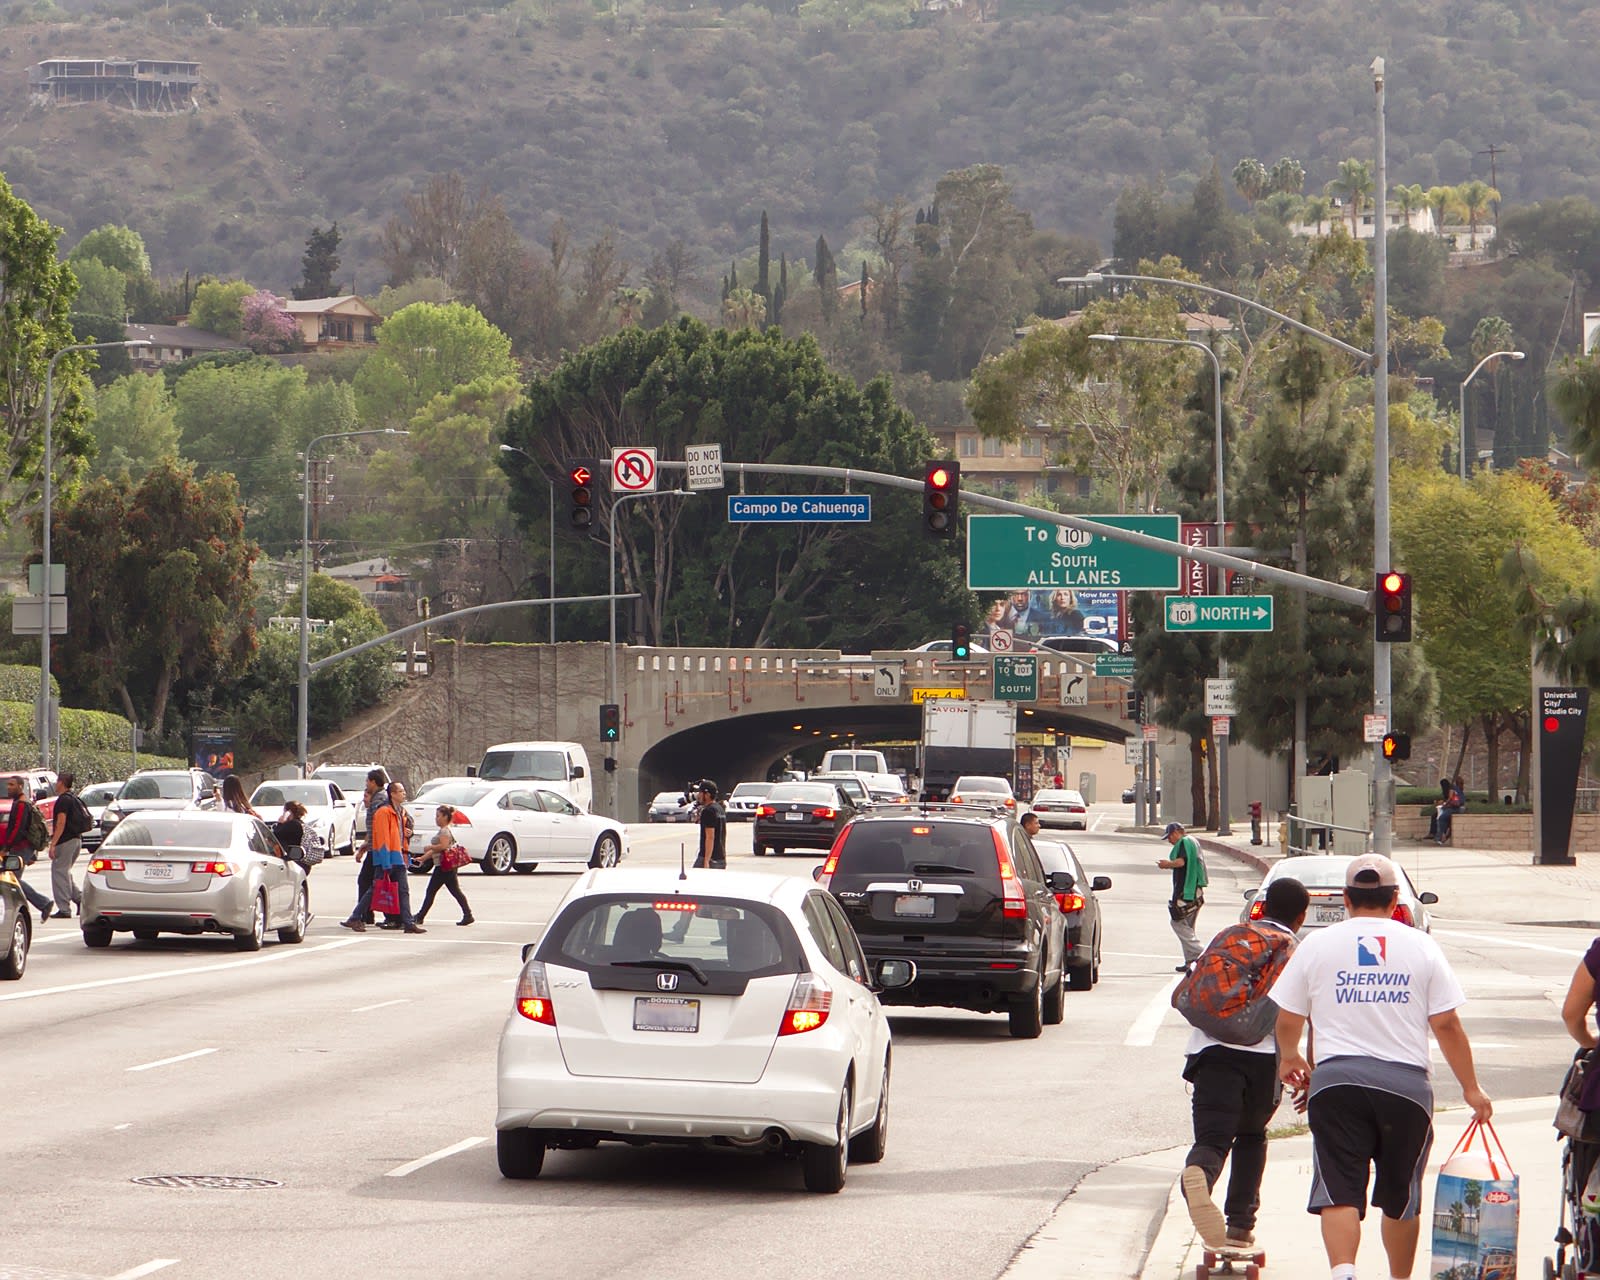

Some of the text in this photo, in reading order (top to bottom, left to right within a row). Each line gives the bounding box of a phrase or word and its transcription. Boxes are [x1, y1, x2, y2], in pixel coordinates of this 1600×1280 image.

[688, 450, 718, 462] DO NOT
[689, 464, 720, 476] BLOCK
[690, 477, 721, 486] INTERSECTION
[733, 502, 865, 517] Campo De Cahuenga
[1065, 529, 1084, 543] 101
[1027, 570, 1121, 585] ALL LANES
[1079, 591, 1098, 599] How
[1176, 607, 1250, 621] 101 NORTH
[999, 666, 1010, 674] TO
[876, 686, 897, 696] ONLY
[1000, 685, 1031, 693] SOUTH
[1063, 695, 1085, 705] ONLY
[1544, 691, 1577, 699] Universal
[1544, 699, 1562, 708] City/
[1568, 708, 1582, 716] City
[1336, 970, 1411, 987] SHERWIN
[650, 997, 685, 1005] DOWNEY
[1336, 988, 1411, 1004] WILLIAMS
[636, 1024, 697, 1033] HONDA WORLD
